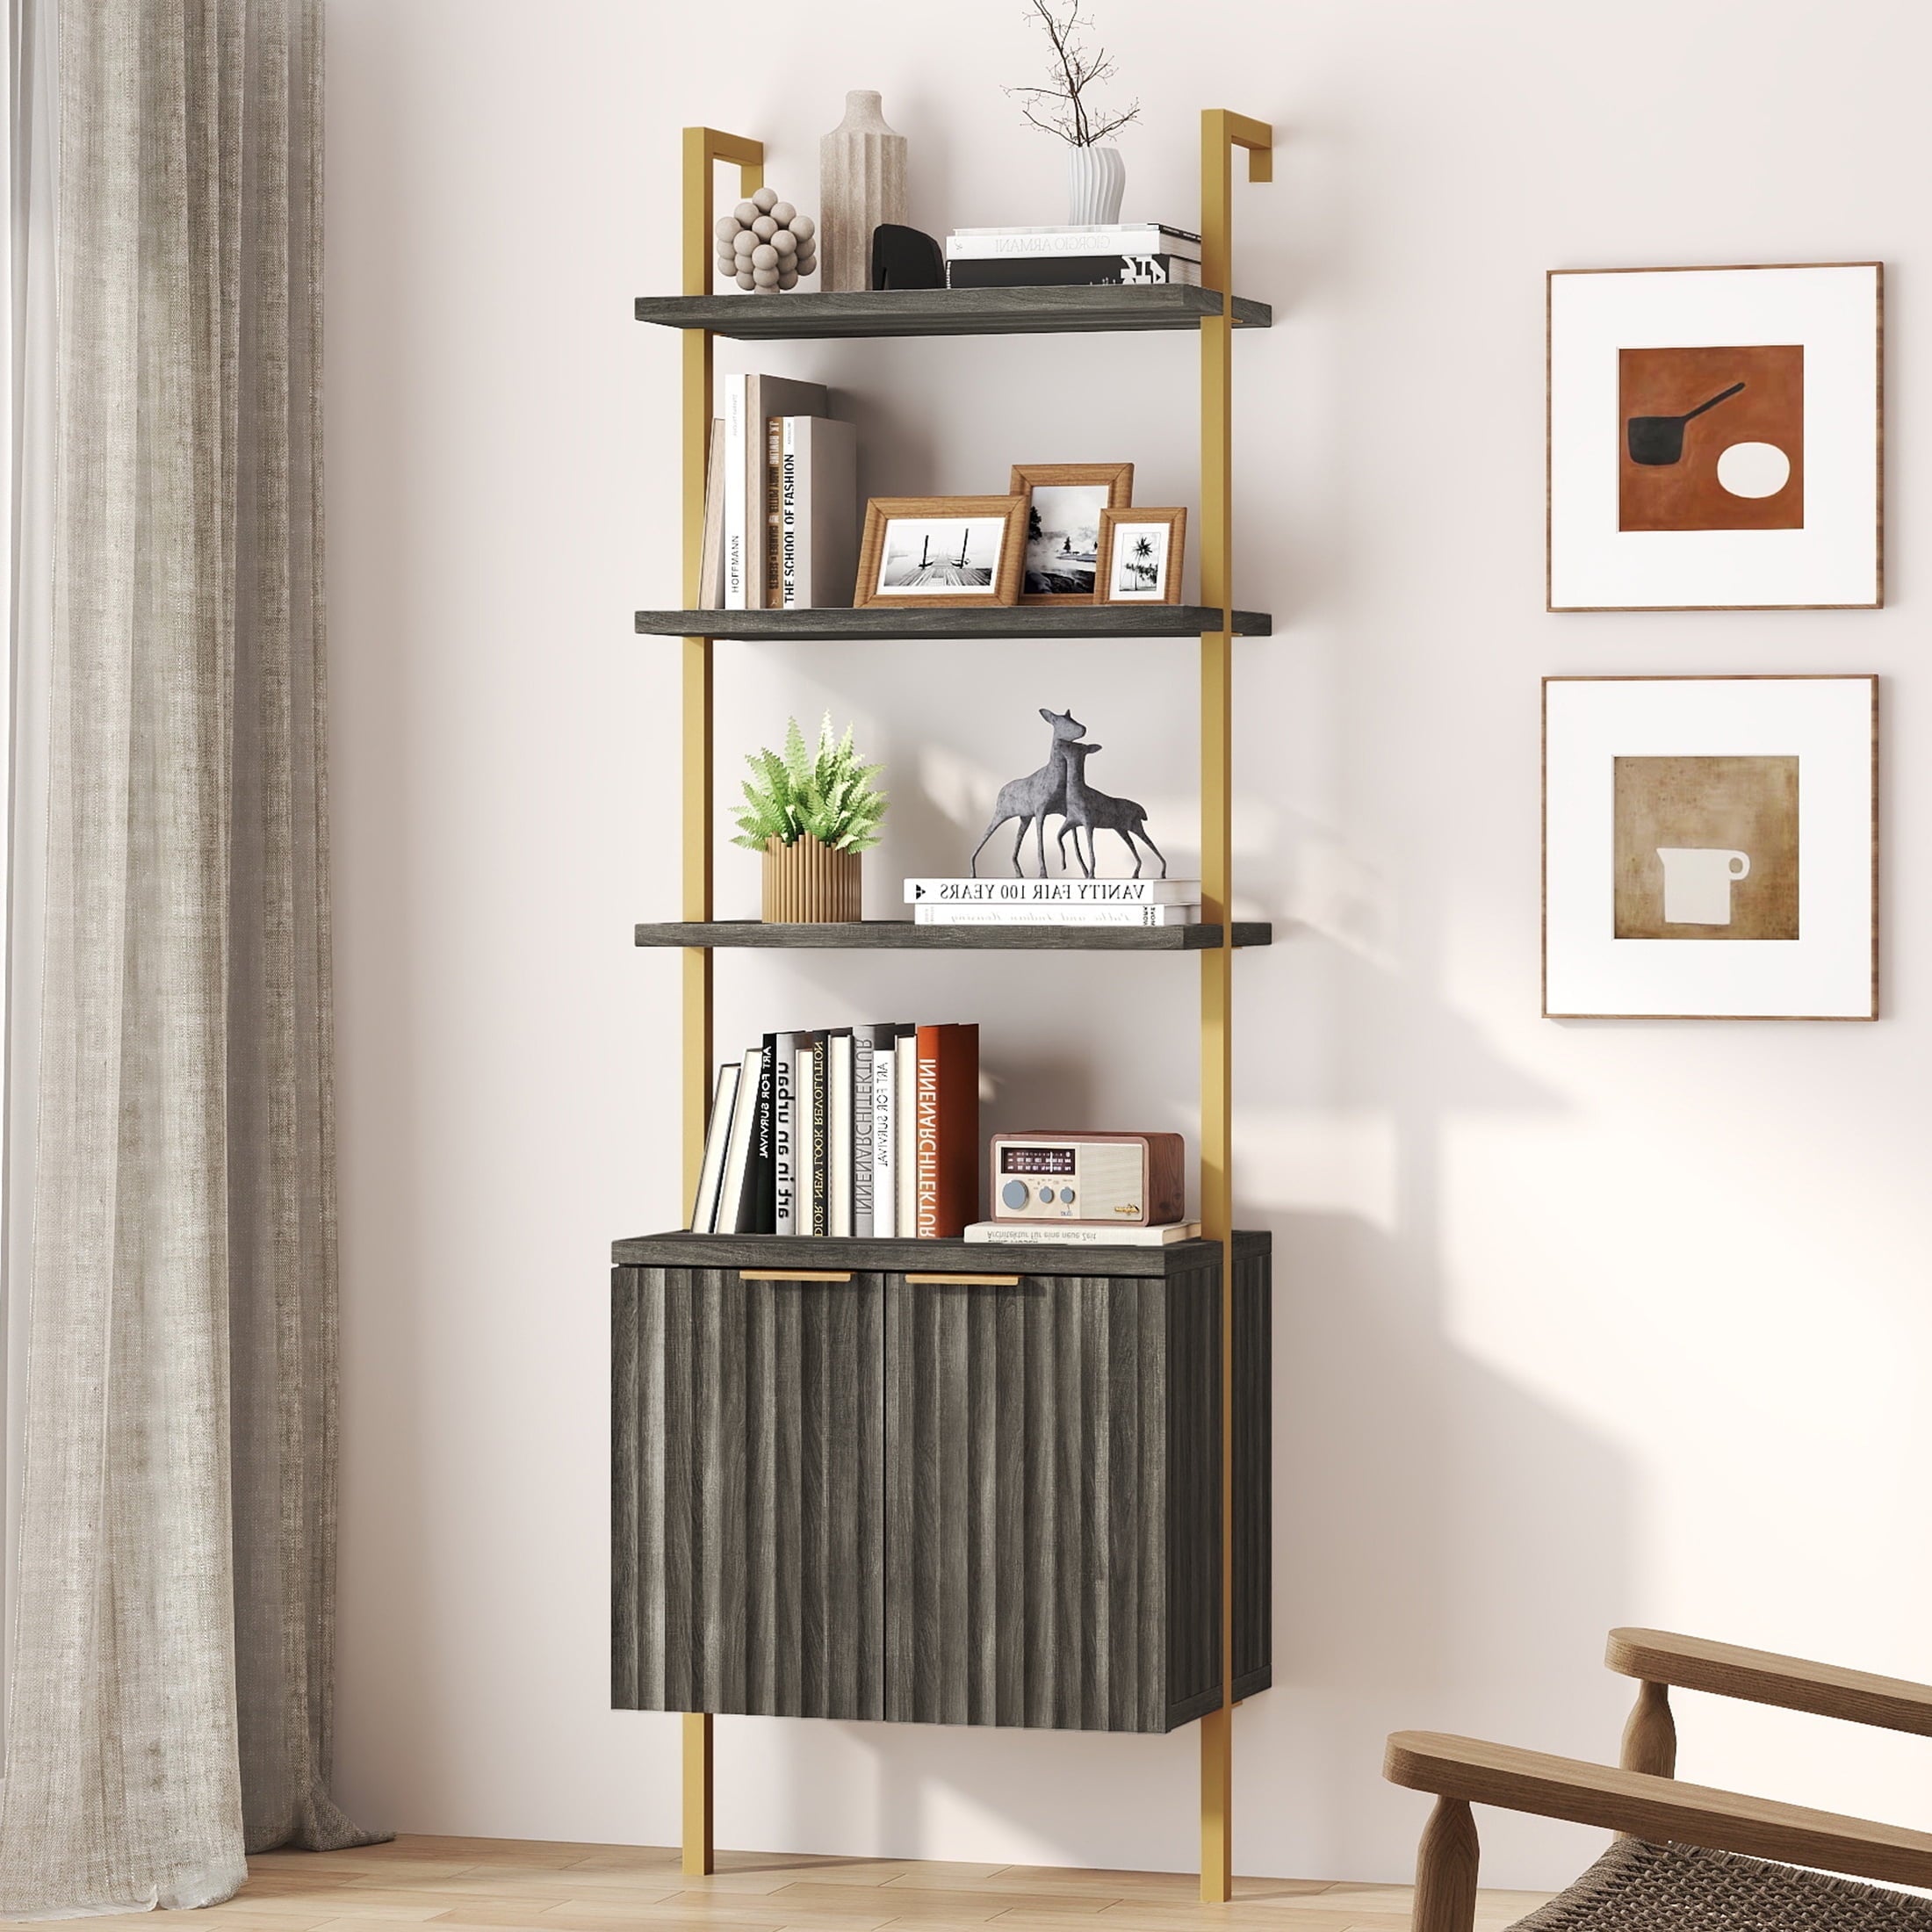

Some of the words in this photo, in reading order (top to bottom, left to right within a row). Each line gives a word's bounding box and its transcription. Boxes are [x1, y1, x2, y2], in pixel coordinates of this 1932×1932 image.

[769, 435, 779, 465] ROWLING
[769, 466, 779, 488] HARRY
[784, 454, 794, 506] FASHION
[769, 489, 779, 514] POTTER
[784, 509, 794, 525] OF
[731, 535, 739, 593] HOFFMANN
[784, 530, 794, 577] SCHOOL
[769, 561, 779, 590] SECRETS
[784, 580, 794, 603] THE
